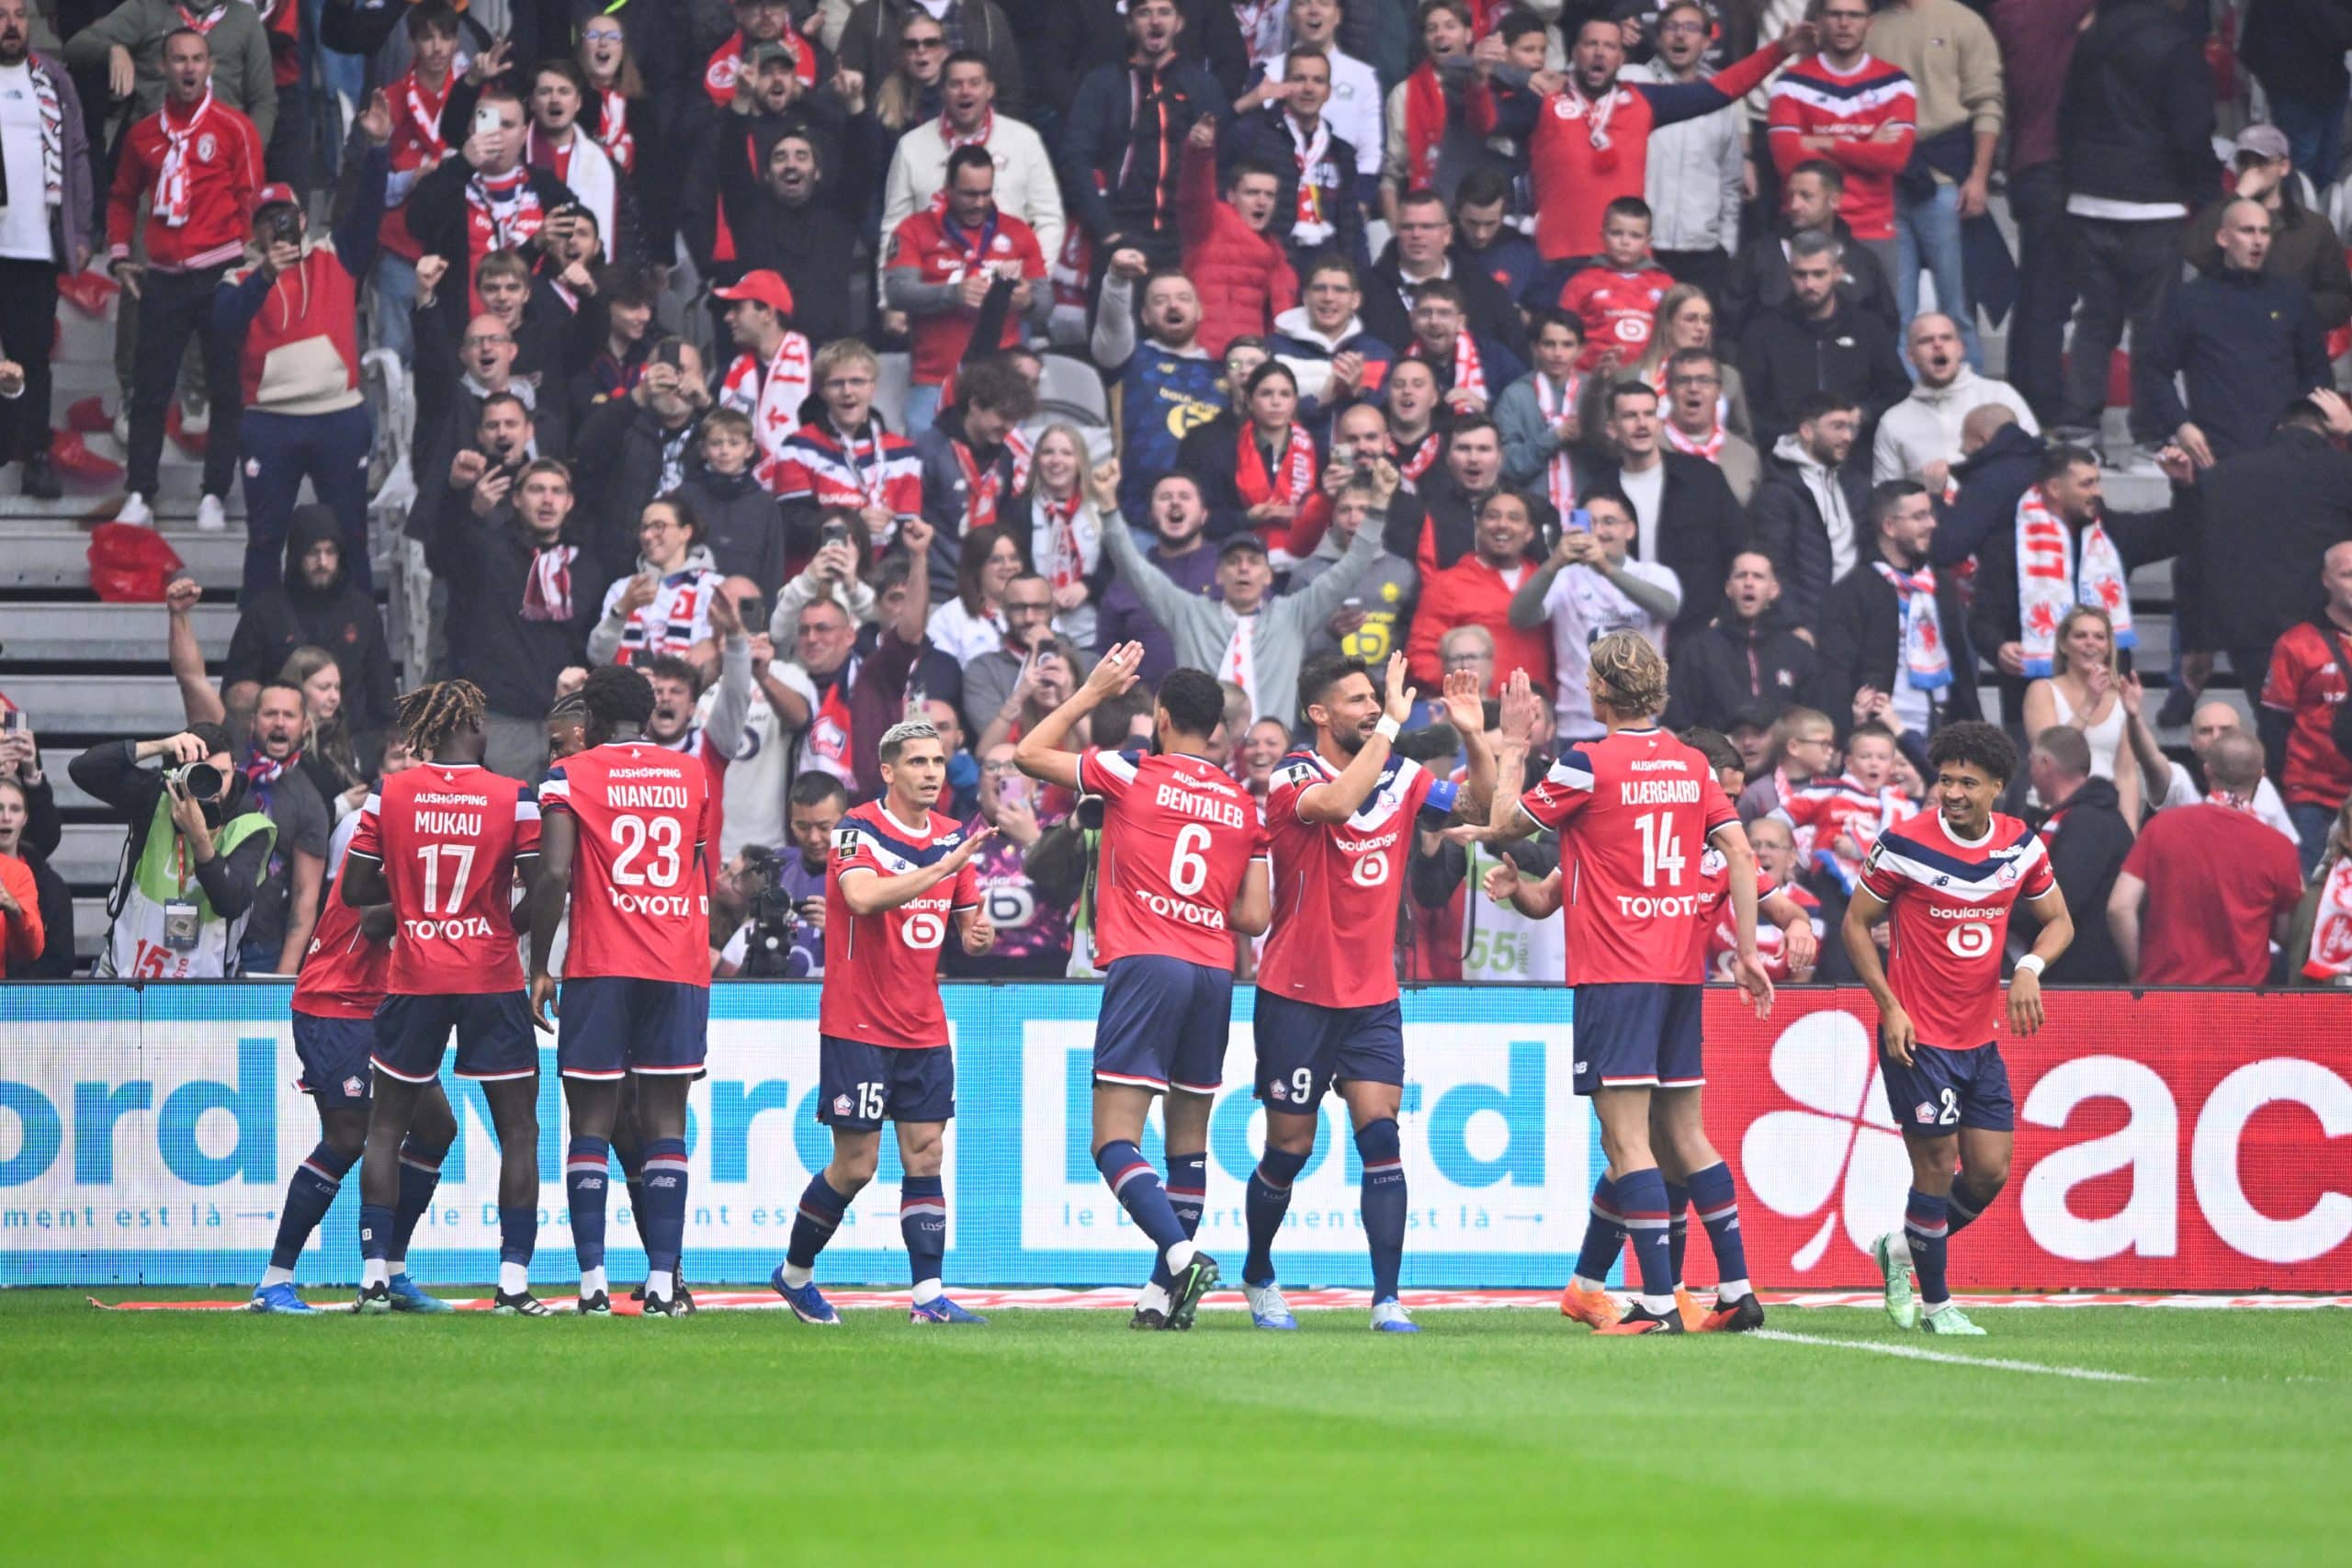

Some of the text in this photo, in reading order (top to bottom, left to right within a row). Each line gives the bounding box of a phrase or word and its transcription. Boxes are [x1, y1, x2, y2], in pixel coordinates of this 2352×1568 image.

[609, 768, 683, 779] AUSHOPPING
[413, 794, 489, 807] AUSHOPPING
[606, 785, 688, 809] NIANZOU
[1155, 784, 1244, 829] BENTALEB
[1621, 780, 1700, 806] KJÆRGAARD
[414, 810, 482, 837] MUKAU
[610, 814, 683, 888] 23
[1334, 829, 1400, 852] boulange
[1634, 811, 1687, 886] 14
[1169, 822, 1213, 897] 6
[416, 843, 477, 915] 17
[1136, 889, 1225, 931] TOYOTA
[1929, 906, 2008, 919] boulanger
[404, 917, 494, 941] TOYOTA
[1466, 928, 1517, 972] 55
[1291, 1066, 1312, 1104] 9
[857, 1081, 884, 1120] 15
[2020, 1054, 2352, 1264] ac
[116, 1206, 170, 1228] est
[191, 1202, 221, 1227] là
[429, 1201, 460, 1226] le
[752, 1205, 797, 1226] es
[1065, 1201, 1094, 1227] le
